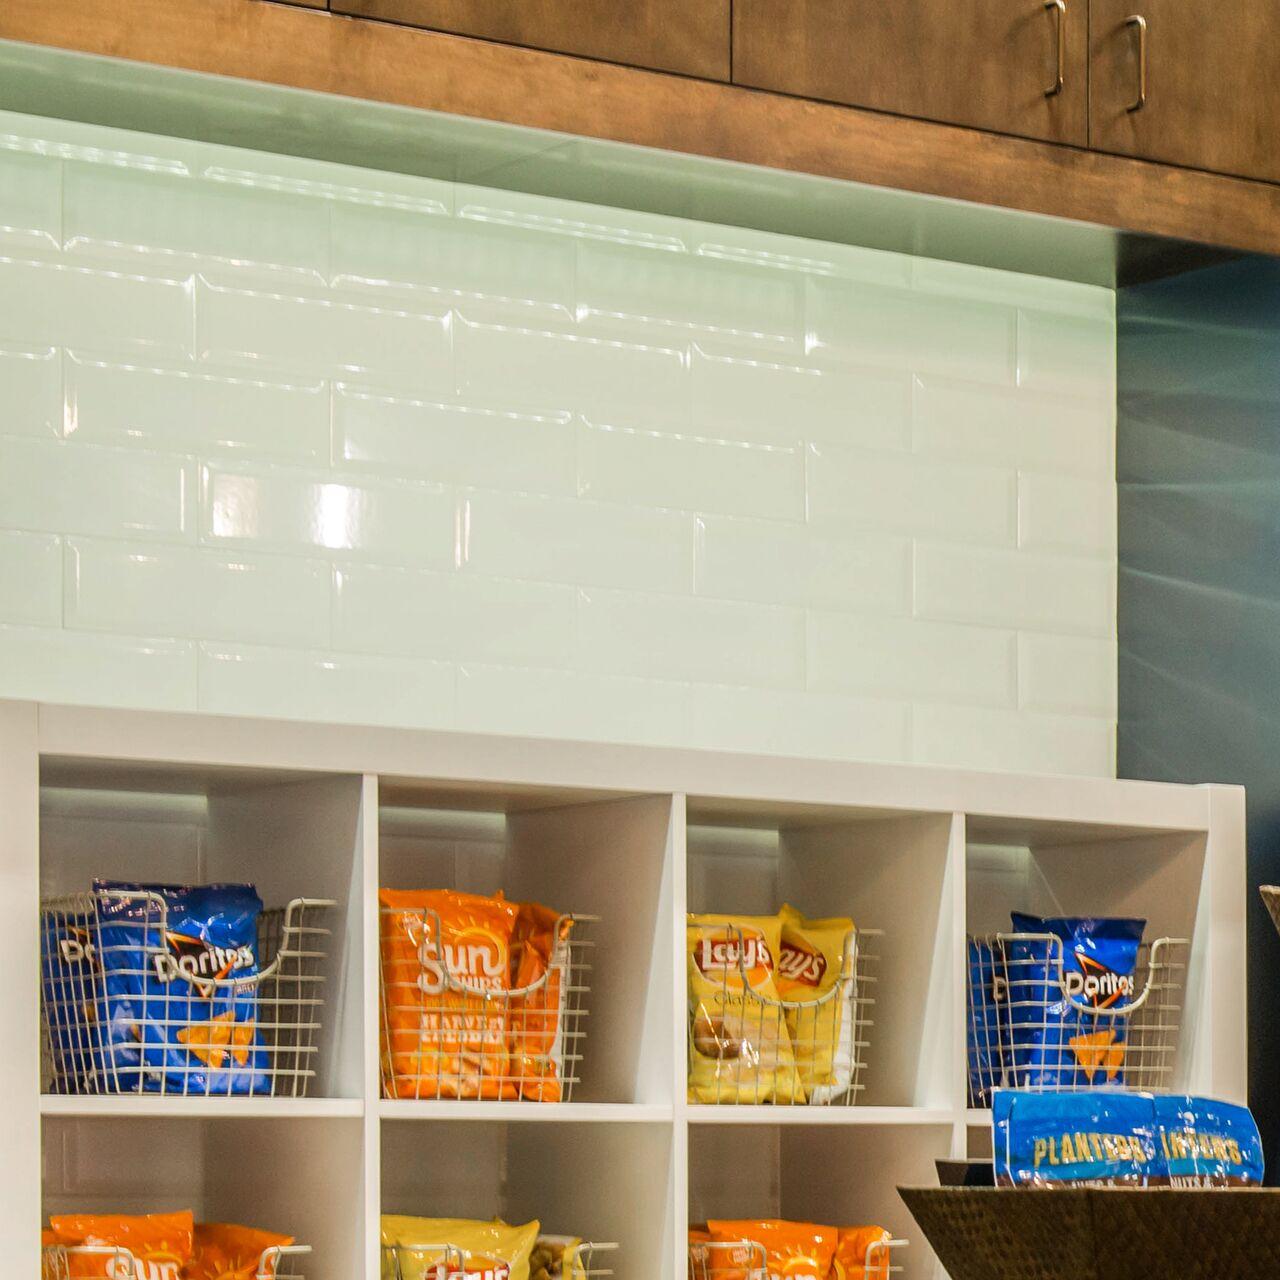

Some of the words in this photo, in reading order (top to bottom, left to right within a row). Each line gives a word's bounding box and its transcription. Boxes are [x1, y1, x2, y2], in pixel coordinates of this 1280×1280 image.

[154, 942, 254, 983] Doritos
[417, 943, 506, 995] Sun
[702, 934, 771, 970] Lay's
[1065, 971, 1134, 998] Doritos
[1033, 1131, 1149, 1169] PLANTERS
